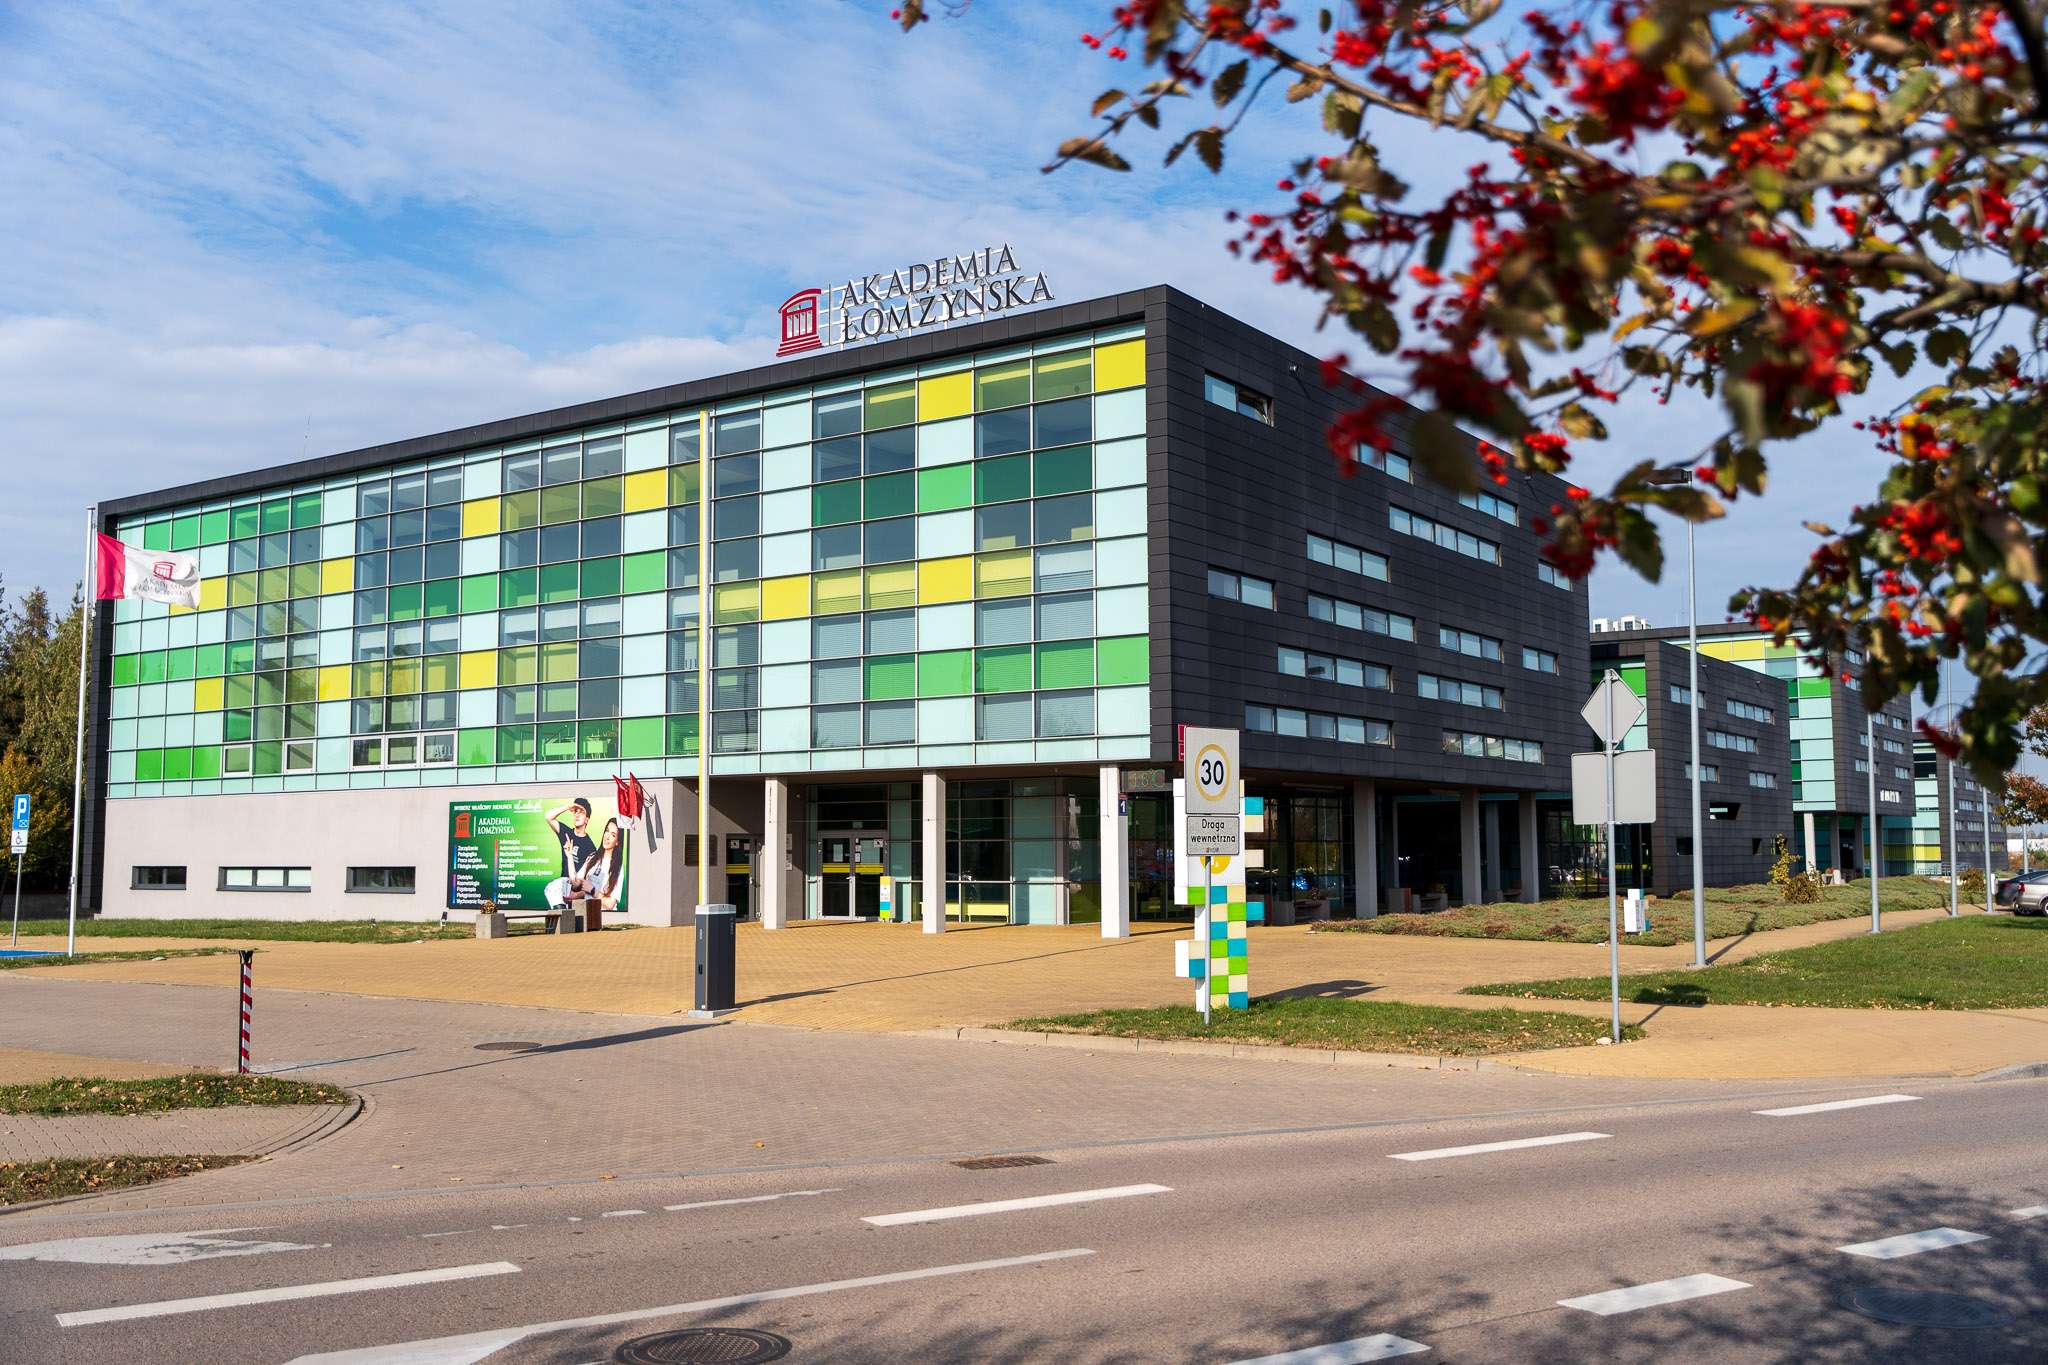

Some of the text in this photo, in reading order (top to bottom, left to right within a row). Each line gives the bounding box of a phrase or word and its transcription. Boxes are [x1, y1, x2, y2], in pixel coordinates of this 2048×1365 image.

[840, 242, 1020, 309] AKADEMIA
[843, 271, 1056, 343] ŁOMŻYŃSKA
[1200, 759, 1224, 786] 30
[16, 797, 27, 820] P
[1120, 800, 1126, 813] 1
[477, 825, 515, 835] ŁOMŻYŃSKA
[478, 817, 511, 826] AKADEMIA
[1201, 818, 1225, 832] Droga
